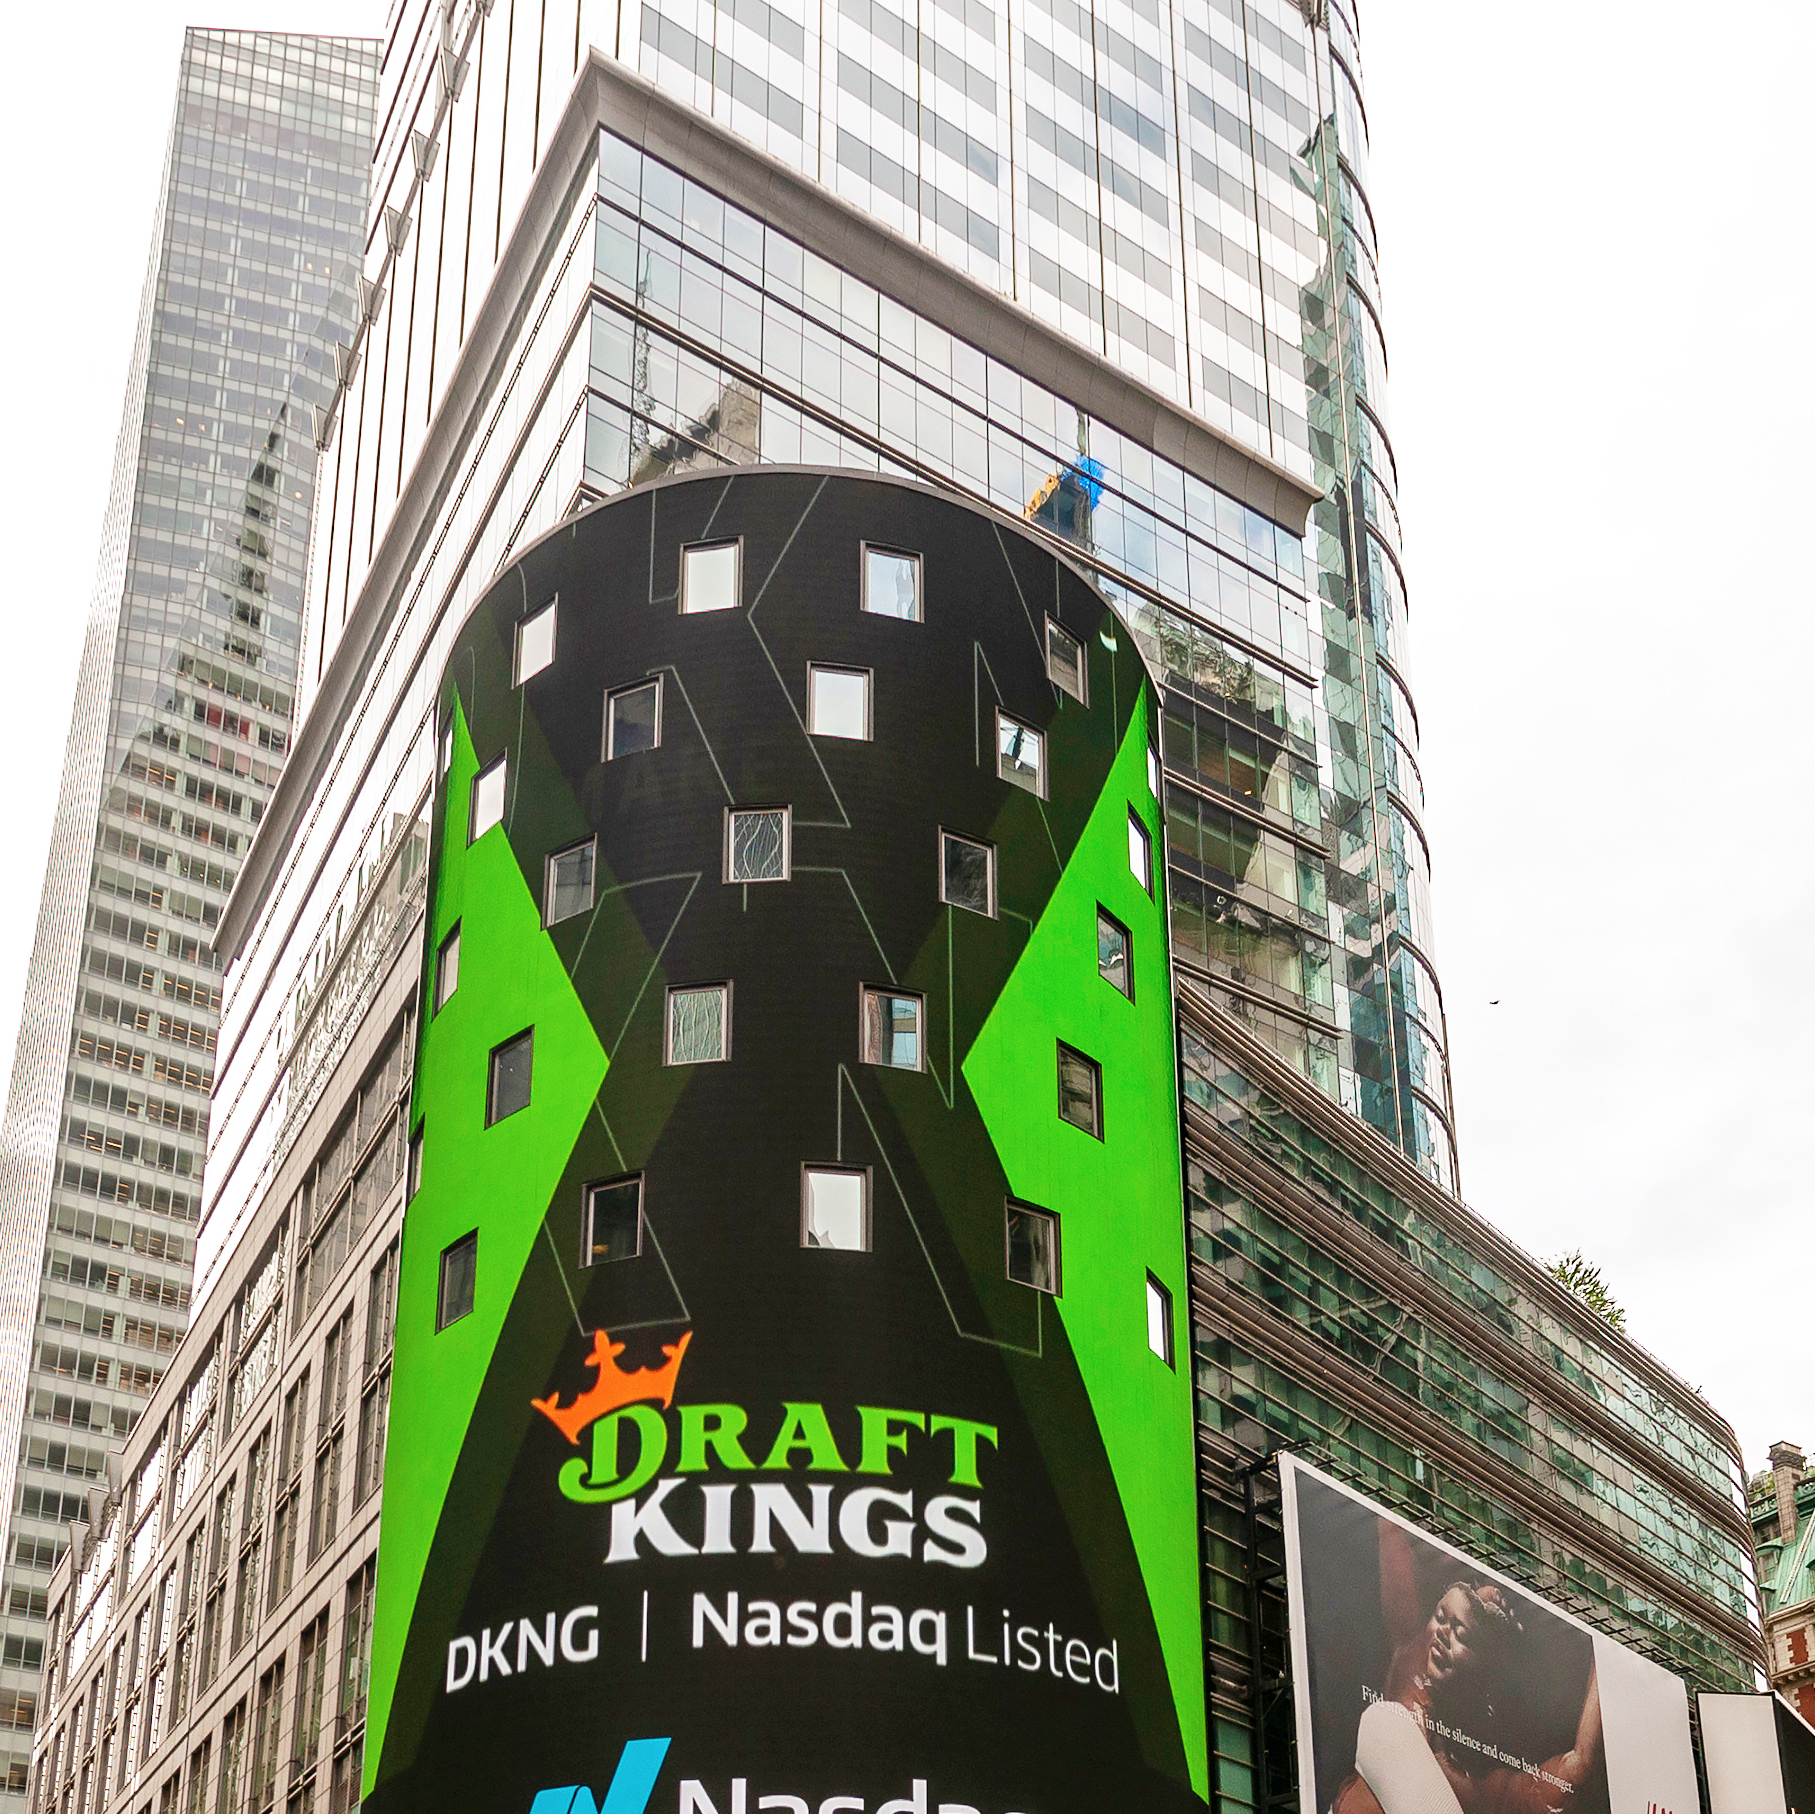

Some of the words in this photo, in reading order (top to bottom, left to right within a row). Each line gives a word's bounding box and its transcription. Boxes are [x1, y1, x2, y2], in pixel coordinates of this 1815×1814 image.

[557, 1401, 999, 1503] DRAFT
[603, 1476, 987, 1570] KINGS
[445, 1604, 600, 1695] DKNG
[691, 1589, 948, 1667] Nasdaq
[966, 1608, 1120, 1695] Listed
[1362, 1685, 1384, 1705] Find
[1386, 1700, 1423, 1727] strength
[1425, 1715, 1435, 1731] in
[1436, 1720, 1451, 1738] the
[1452, 1728, 1481, 1751] silence
[1482, 1742, 1498, 1759] and
[1499, 1752, 1521, 1770] come
[1522, 1758, 1540, 1779] back
[1542, 1770, 1574, 1794] stronger.
